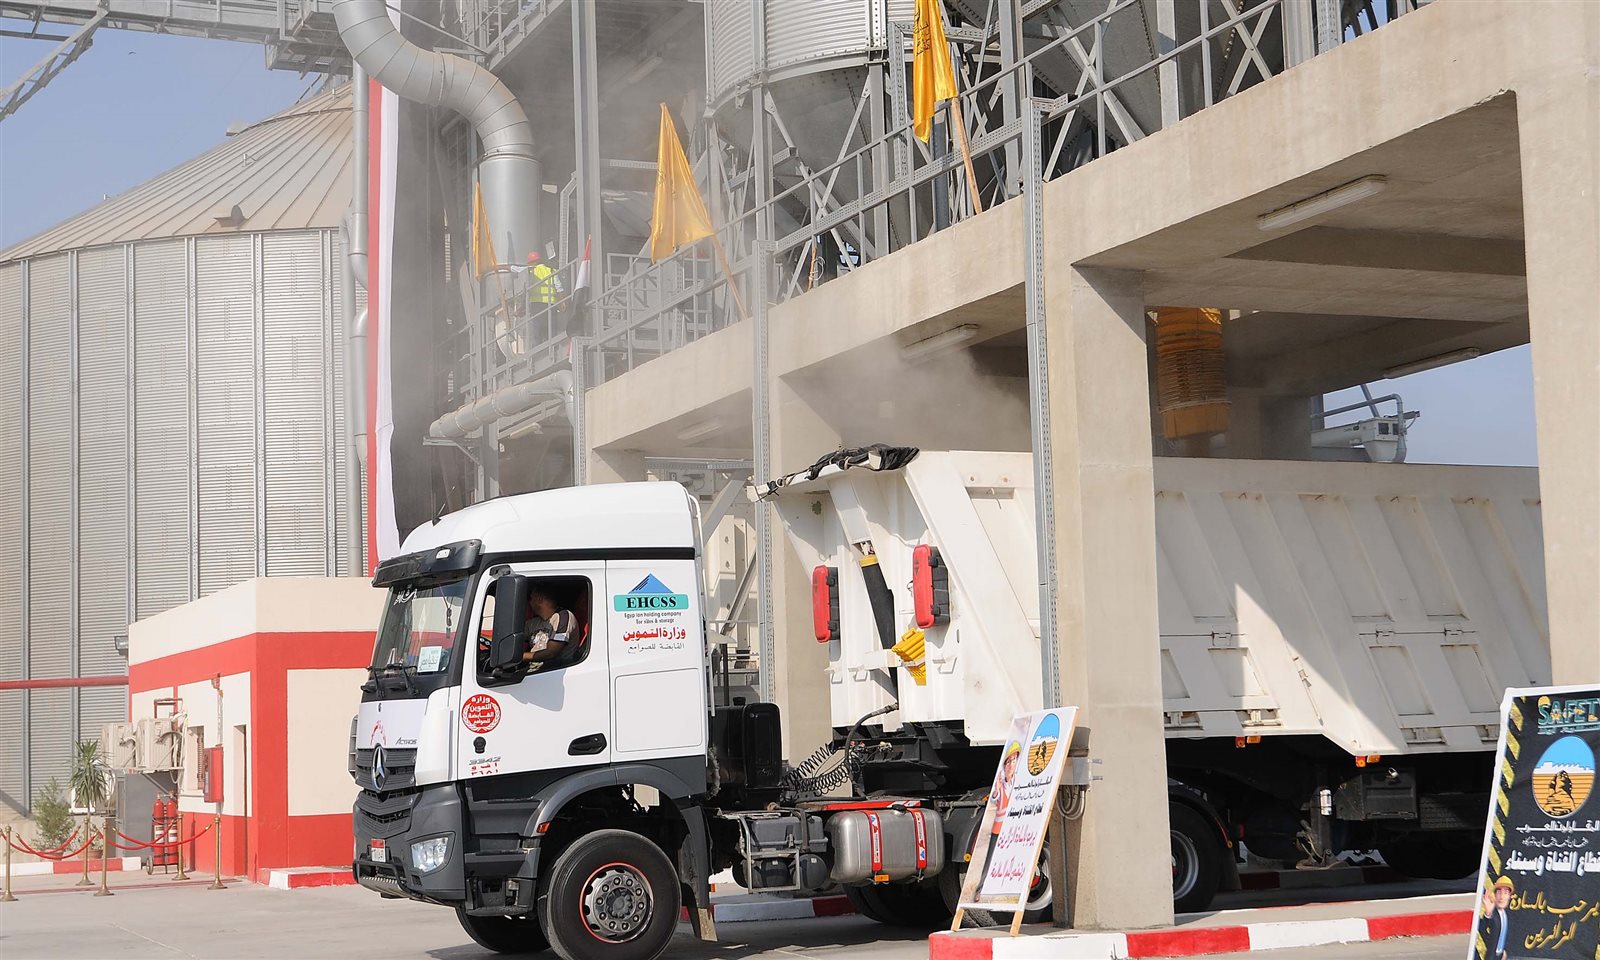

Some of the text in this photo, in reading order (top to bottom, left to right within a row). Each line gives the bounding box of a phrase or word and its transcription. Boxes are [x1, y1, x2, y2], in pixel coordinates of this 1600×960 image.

[626, 596, 677, 609] EHCSS
[623, 626, 686, 641] وزارة التموين
[1538, 698, 1600, 725] SAFET
[1504, 850, 1545, 877] وسيناء
[1545, 851, 1578, 872] القناة
[1509, 890, 1547, 914] بالسادة
